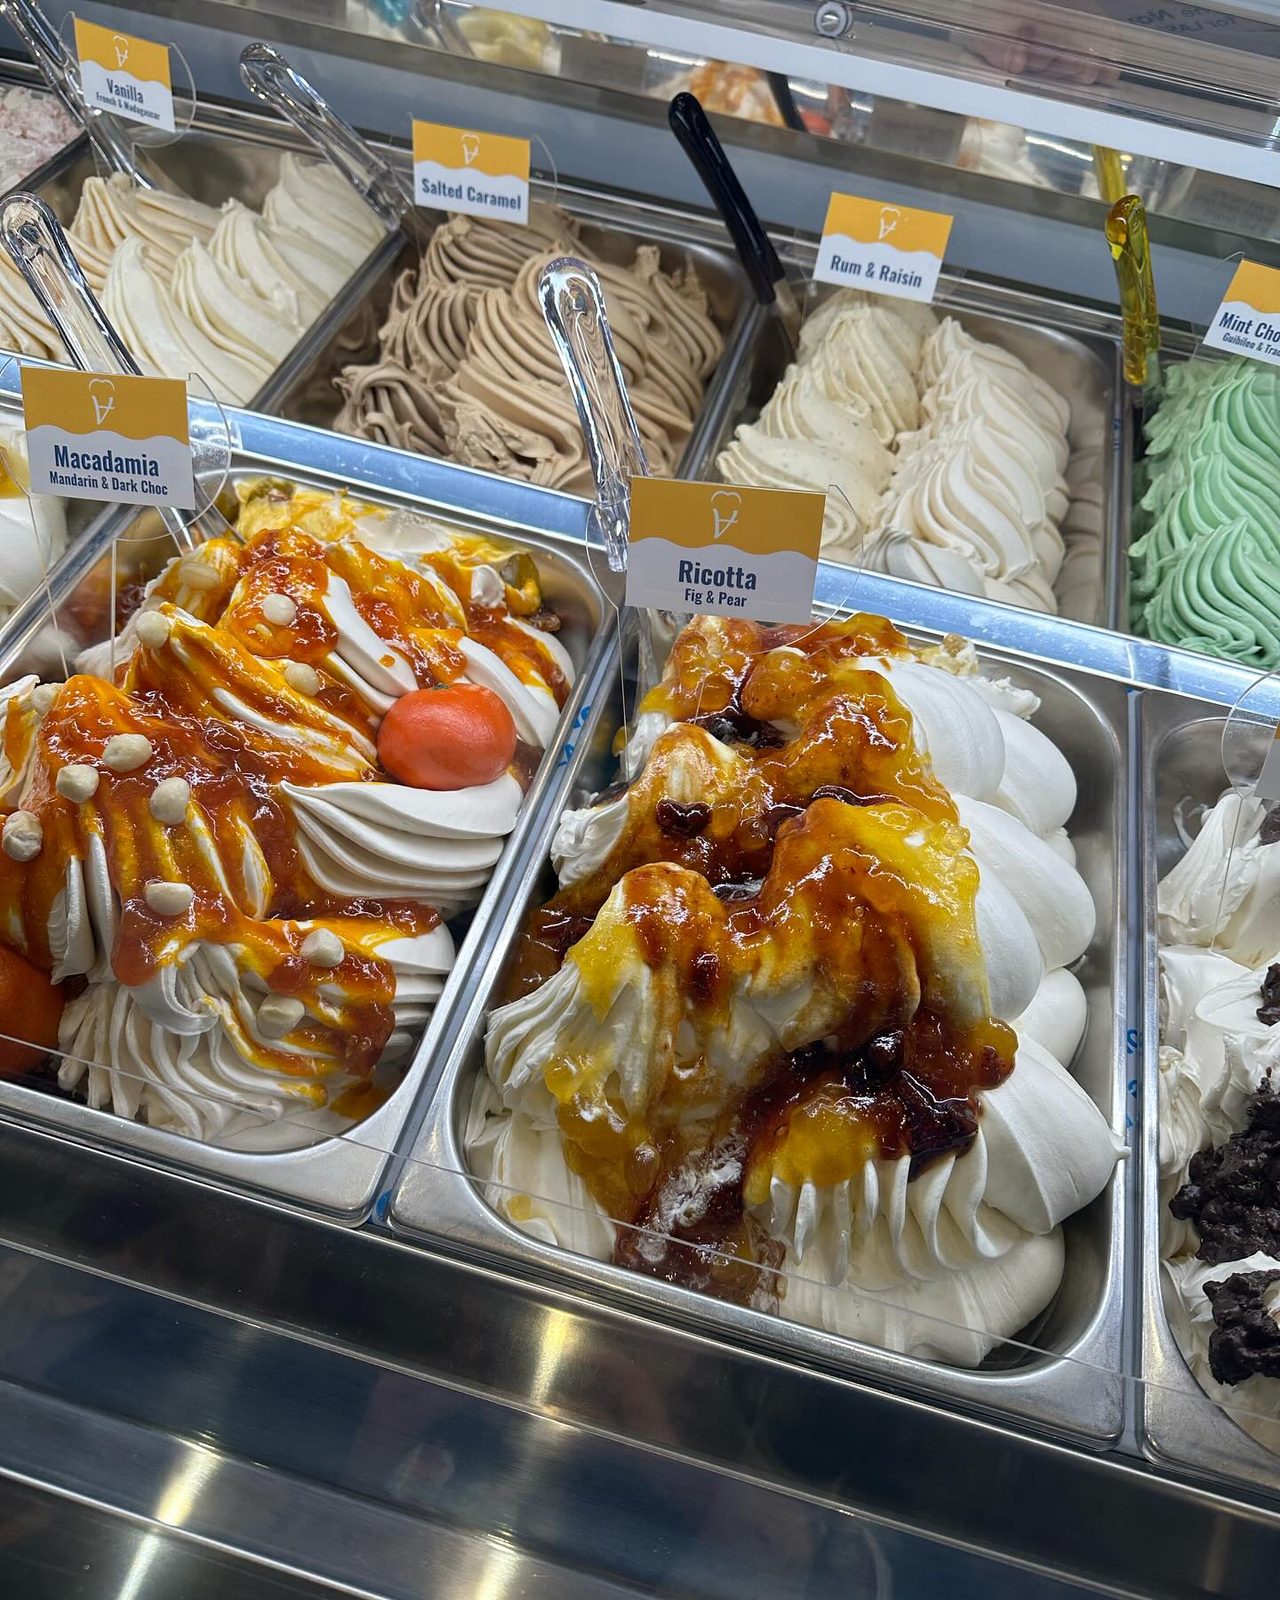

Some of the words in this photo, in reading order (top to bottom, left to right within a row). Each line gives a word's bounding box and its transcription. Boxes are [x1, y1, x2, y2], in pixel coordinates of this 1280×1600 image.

[106, 78, 144, 104] Vanilla
[96, 92, 117, 106] French
[118, 99, 123, 108] &
[124, 101, 160, 120] Madagascar
[421, 178, 463, 200] Salted
[467, 186, 522, 211] Caramel
[830, 255, 861, 276] Rum
[865, 262, 875, 278] &
[879, 265, 922, 288] Raisin
[1219, 312, 1253, 335] Mint
[1256, 342, 1264, 352] &
[54, 445, 159, 477] Macadamia
[50, 471, 99, 489] Mandarin
[101, 476, 109, 490] &
[112, 477, 138, 493] Dark
[141, 480, 168, 496] Choc
[678, 560, 757, 590] Ricotta
[685, 588, 703, 605] Fig
[706, 590, 714, 605] &
[718, 592, 747, 607] Pear
